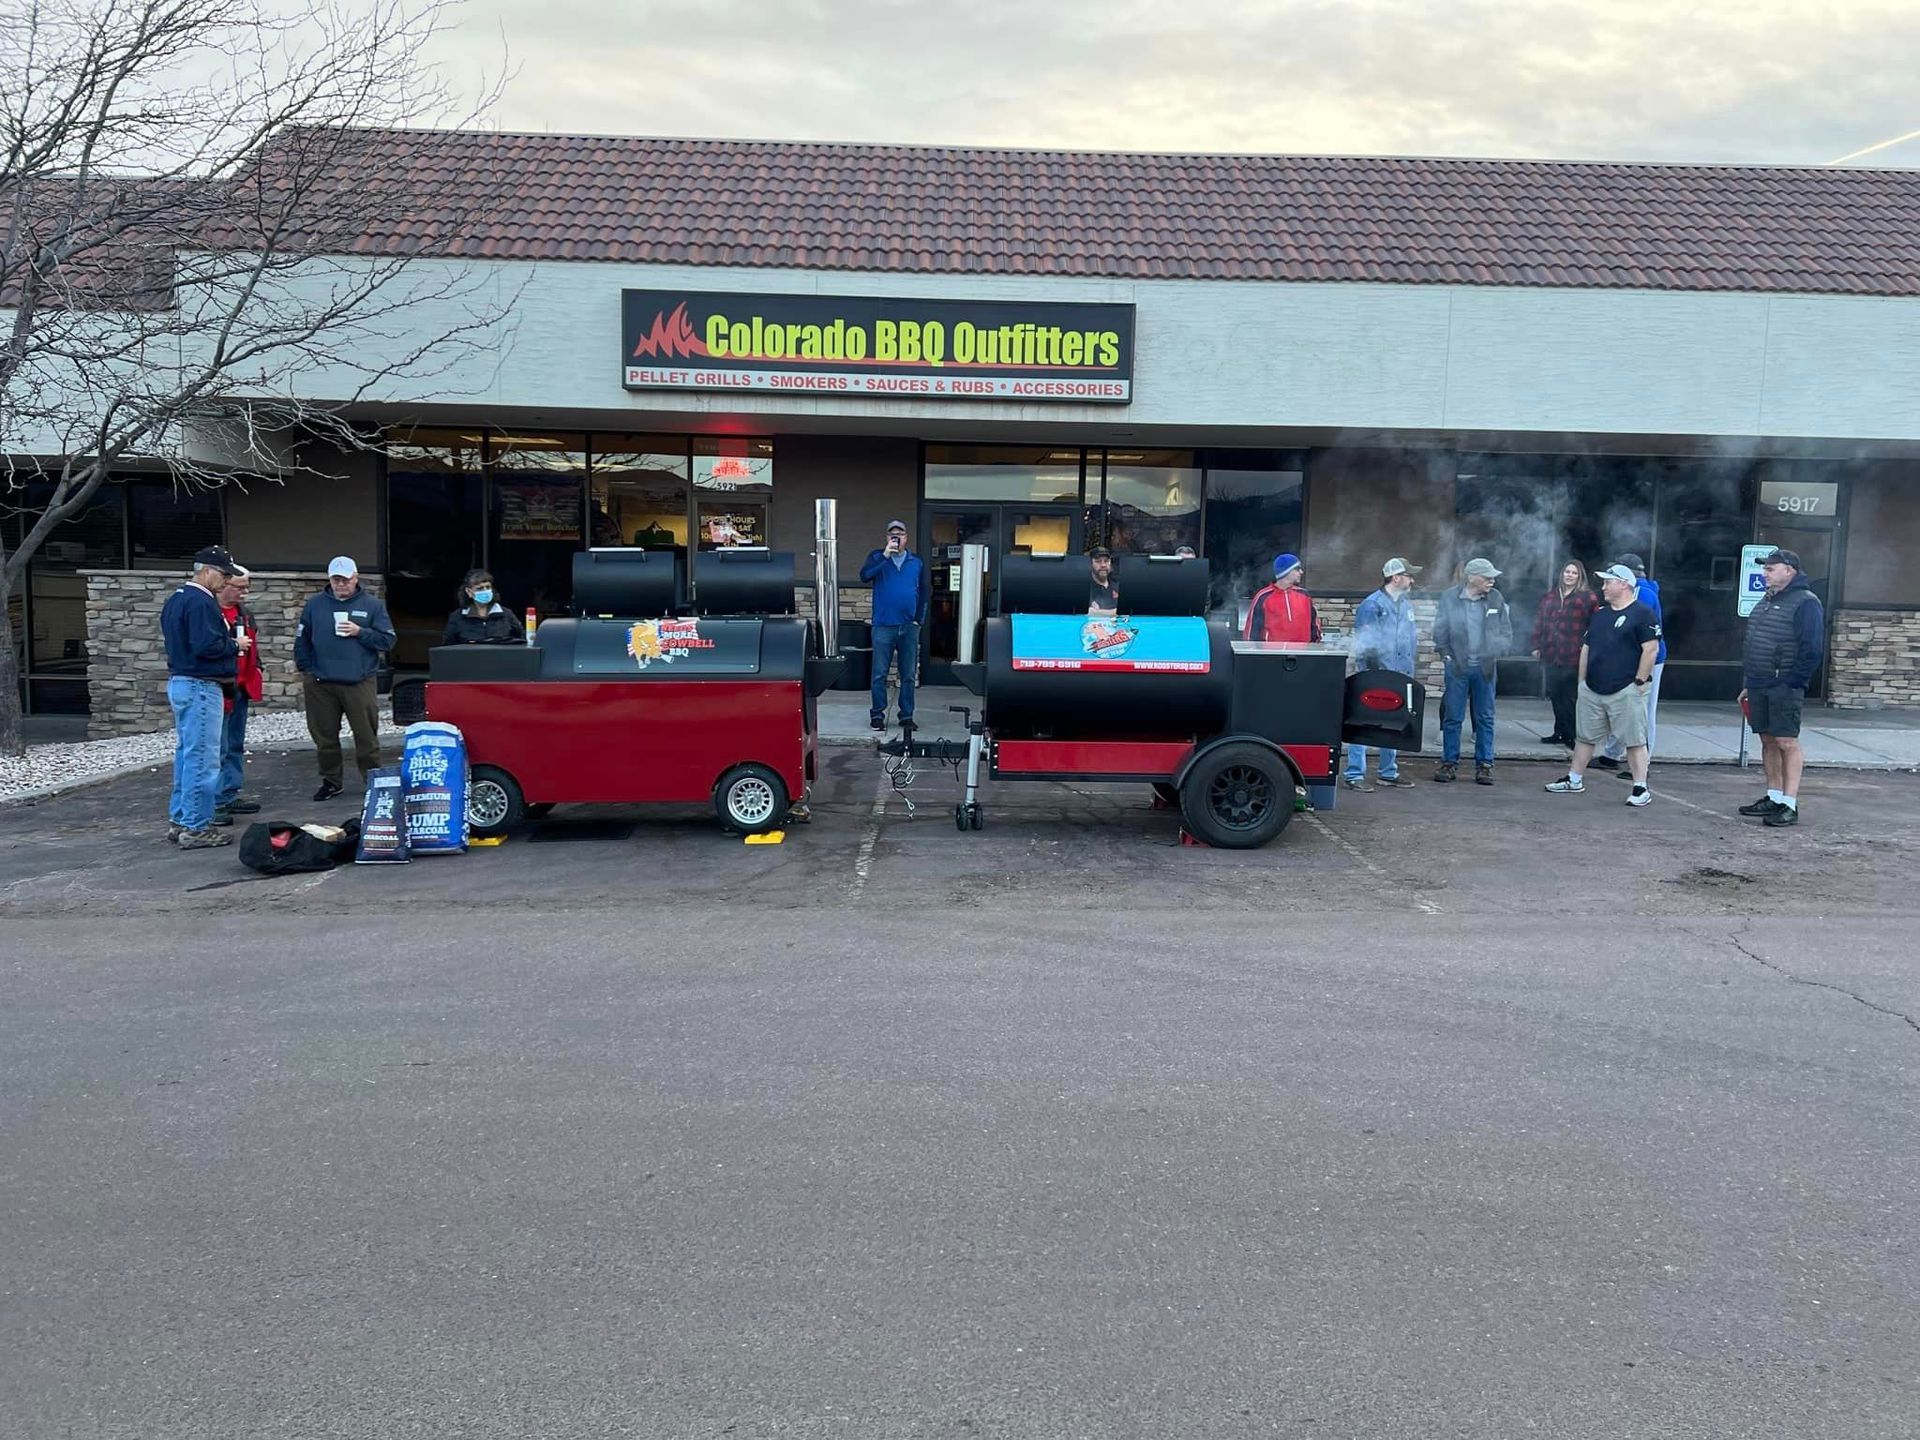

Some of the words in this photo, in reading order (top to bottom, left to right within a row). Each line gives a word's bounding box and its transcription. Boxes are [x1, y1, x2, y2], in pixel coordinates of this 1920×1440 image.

[706, 314, 867, 361] Colorado
[875, 320, 945, 367] BBQ
[953, 321, 1119, 366] Outfitters
[630, 370, 689, 384] PELLET
[694, 372, 751, 386] GRILLS
[770, 375, 848, 389] SMOKERS
[866, 378, 929, 392] SAUCES
[935, 380, 946, 392] &
[952, 381, 994, 393] RUBS
[1013, 382, 1123, 395] ACCESSORIES
[717, 482, 737, 491] 5921
[1777, 496, 1819, 512] 5917
[730, 516, 756, 524] HOURS
[660, 639, 715, 651] COWBELL
[669, 648, 689, 657] BBQ
[410, 756, 449, 771] Blues
[411, 769, 443, 785] Hog
[405, 793, 451, 802] PREMIUM
